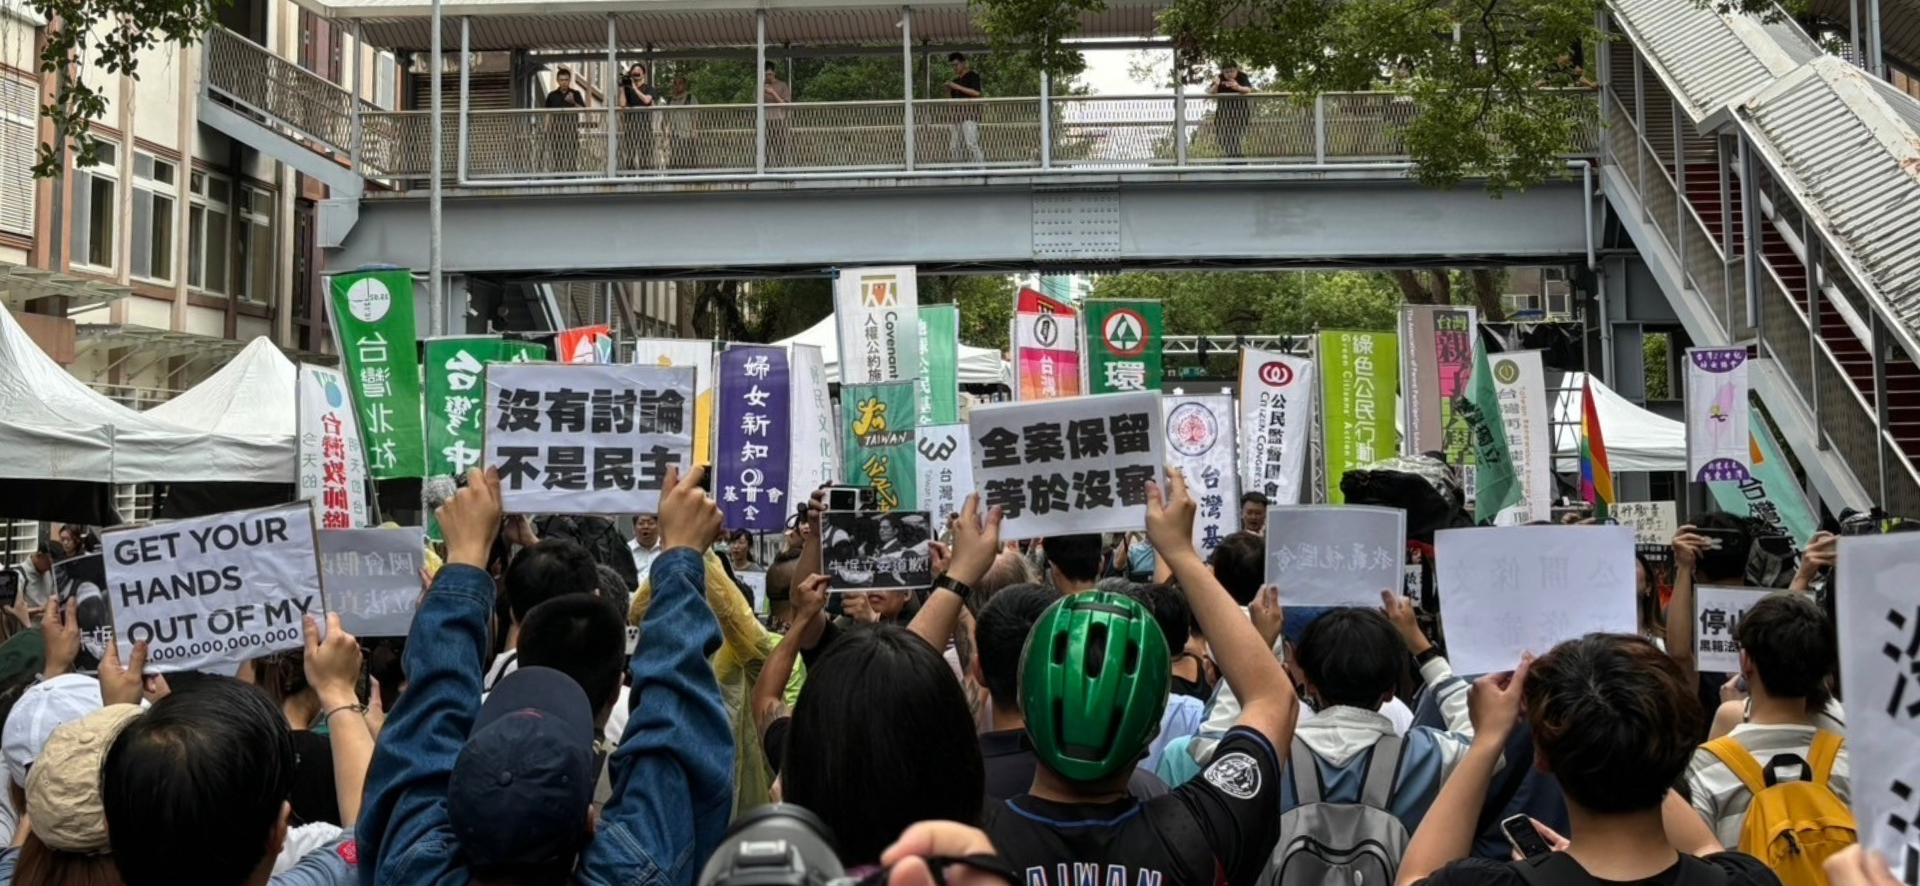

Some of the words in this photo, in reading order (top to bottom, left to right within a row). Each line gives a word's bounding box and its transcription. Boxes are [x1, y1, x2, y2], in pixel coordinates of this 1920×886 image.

[885, 311, 899, 379] Covenant
[1341, 334, 1350, 367] Green
[1104, 361, 1146, 391] 環
[497, 388, 686, 434] 沒有討論
[741, 355, 771, 462] 婦女新知
[864, 431, 907, 446] TAIWAN
[979, 412, 1151, 469] 全案保留
[1253, 434, 1267, 488] CONGRESS
[1264, 393, 1286, 506] 公民監督國會
[1343, 422, 1353, 454] Action
[496, 445, 682, 491] 不是民主
[722, 485, 784, 521] 基金會
[984, 464, 1155, 520] 等於沒審
[1200, 465, 1224, 566] 台灣基
[114, 532, 180, 565] GET
[189, 516, 288, 554] YOUR
[120, 566, 242, 607] HANDS
[127, 613, 198, 646] OUT
[208, 605, 254, 635] OF
[264, 595, 313, 627] MY
[144, 628, 298, 662] ,000,000,000,000
